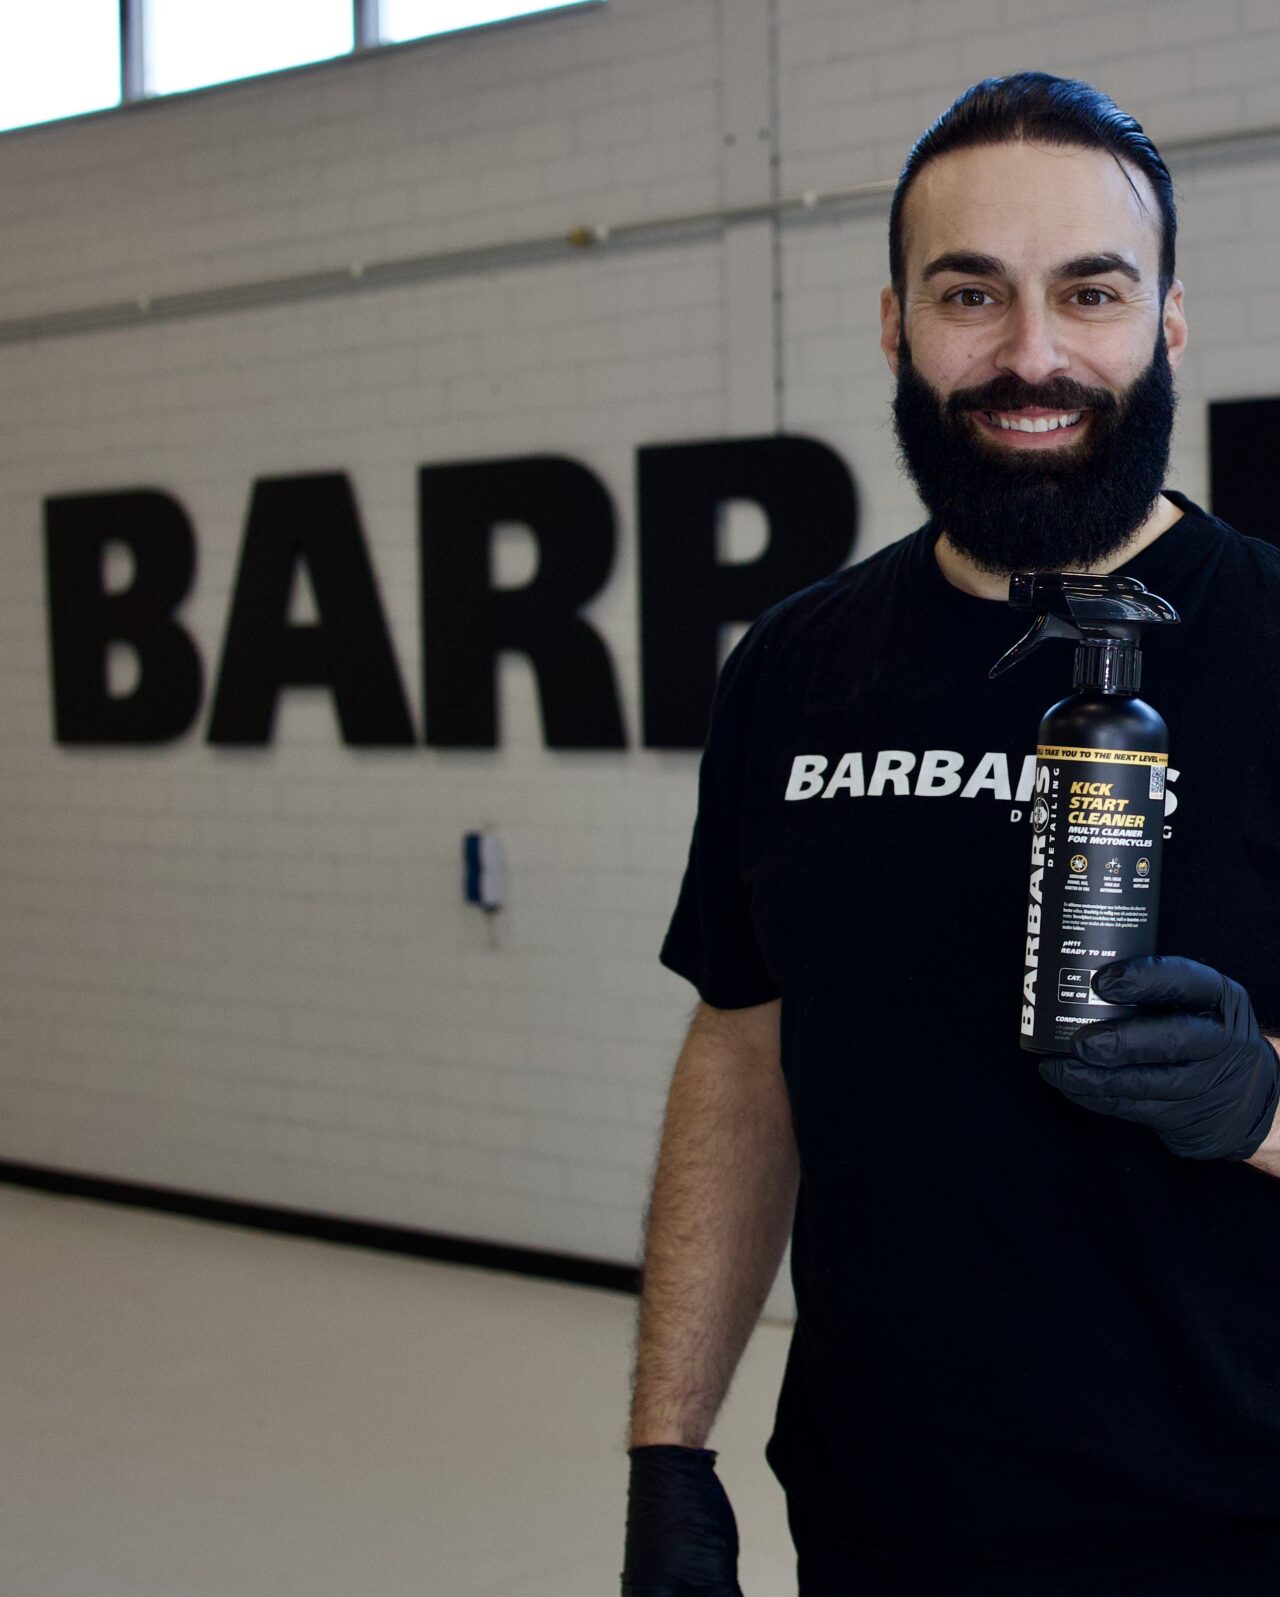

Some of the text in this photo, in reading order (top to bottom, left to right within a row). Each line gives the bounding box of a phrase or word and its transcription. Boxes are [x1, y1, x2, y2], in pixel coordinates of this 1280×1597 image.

[1044, 749, 1060, 757] TAKE
[1062, 750, 1077, 758] YOU
[1094, 752, 1112, 760] THE
[1113, 753, 1137, 762] NEXT
[1139, 755, 1158, 763] LEVEL
[1069, 781, 1114, 796] KICK
[1068, 796, 1130, 812] START
[1047, 767, 1060, 867] DETAILING
[1067, 811, 1146, 828] CLEANER
[1068, 826, 1143, 838] MULTI CLEANER
[1067, 835, 1153, 848] FOR MOTORCYCLES
[1060, 947, 1087, 956] READY
[1088, 949, 1100, 957] TO
[1066, 974, 1082, 982] CAT.
[1060, 990, 1075, 998] USE
[1075, 991, 1088, 999] ON
[1055, 1015, 1108, 1025] COMPOSIT
